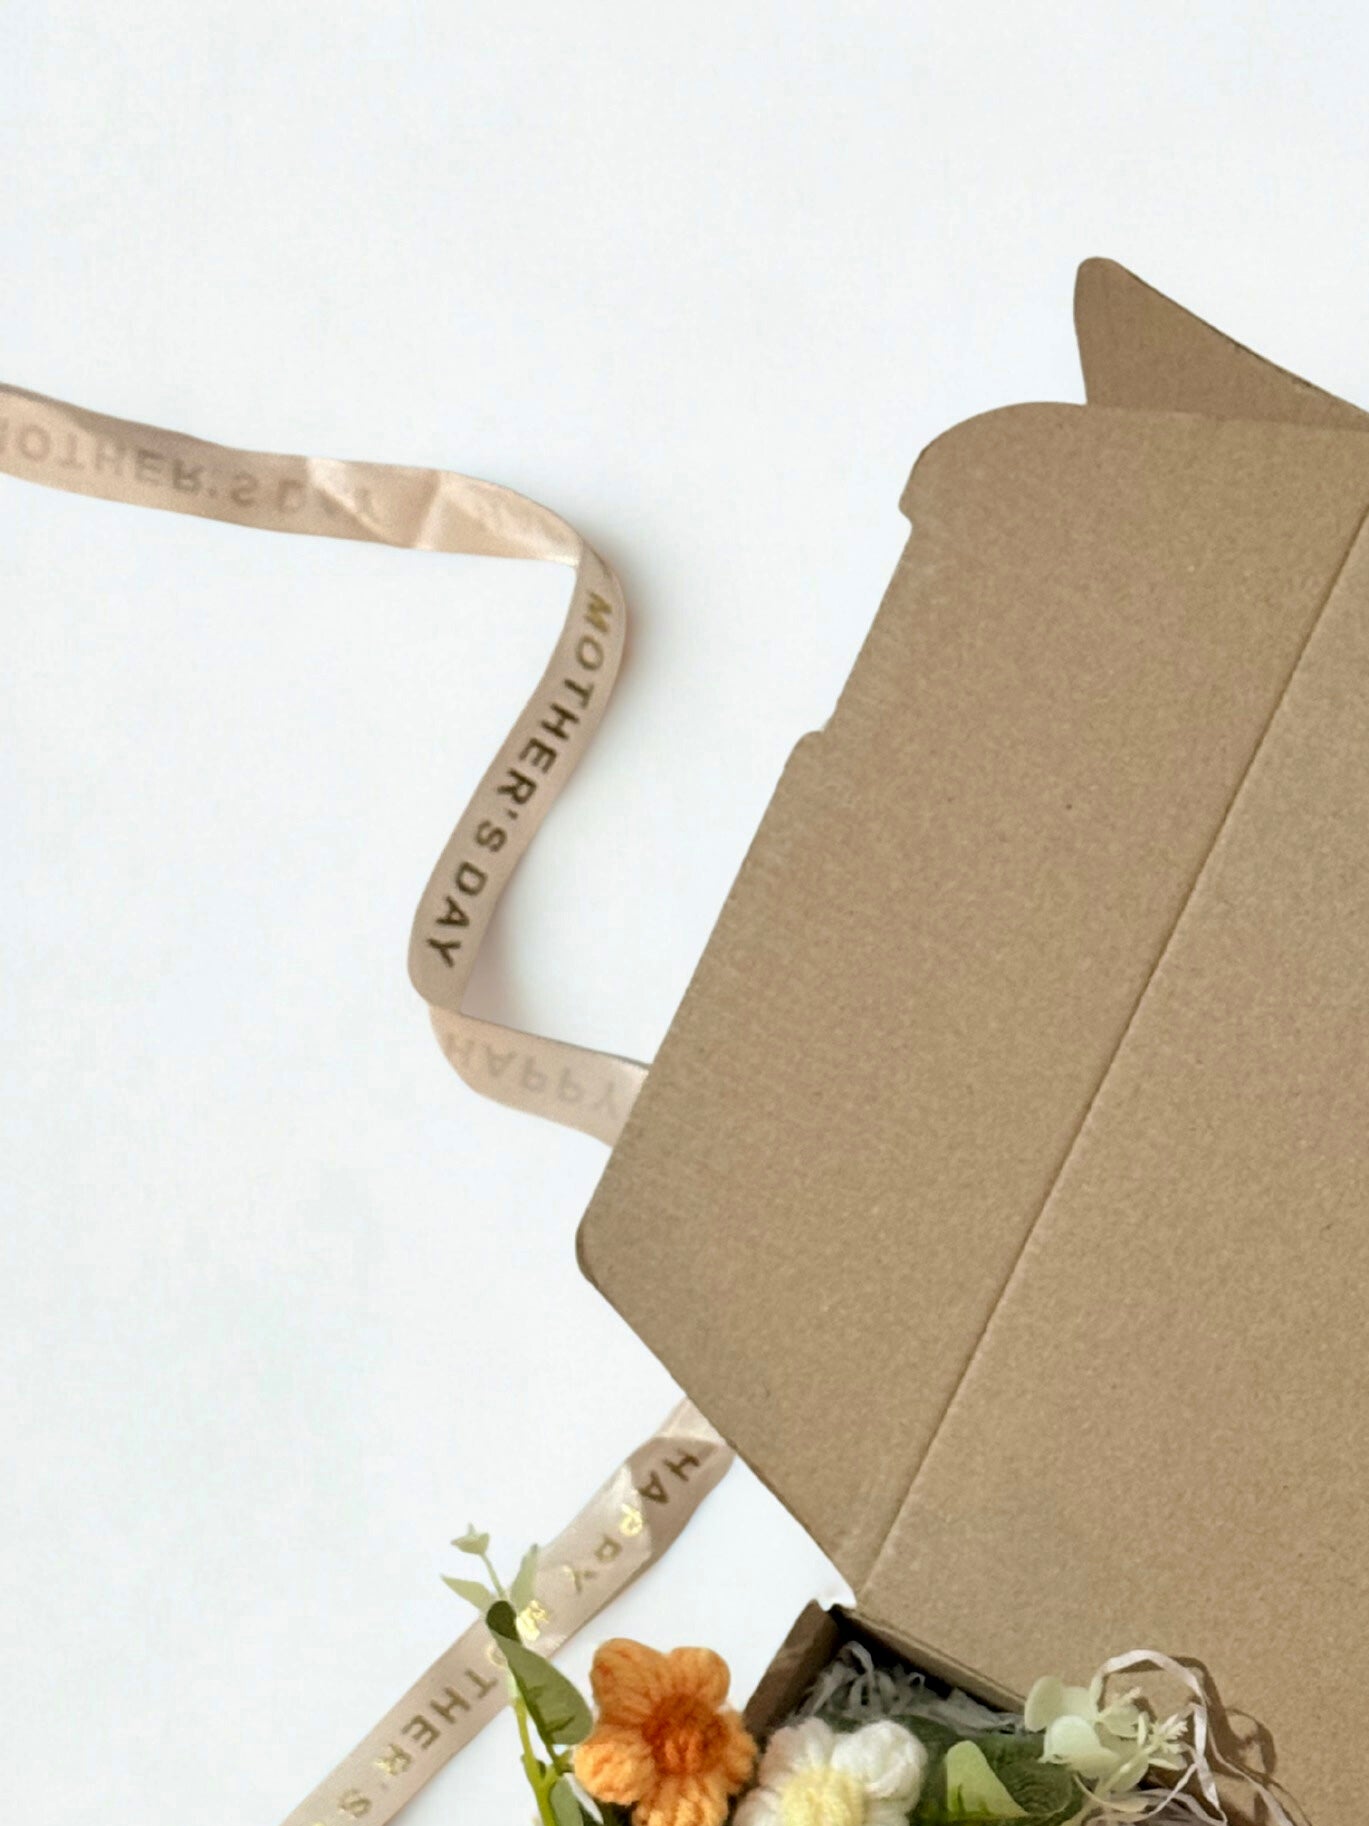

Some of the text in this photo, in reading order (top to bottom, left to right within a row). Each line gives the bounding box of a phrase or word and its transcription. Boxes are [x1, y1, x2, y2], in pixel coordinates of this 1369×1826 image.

[426, 592, 612, 968] MOTHER'S DAY
[561, 1448, 707, 1594] HAPPY
